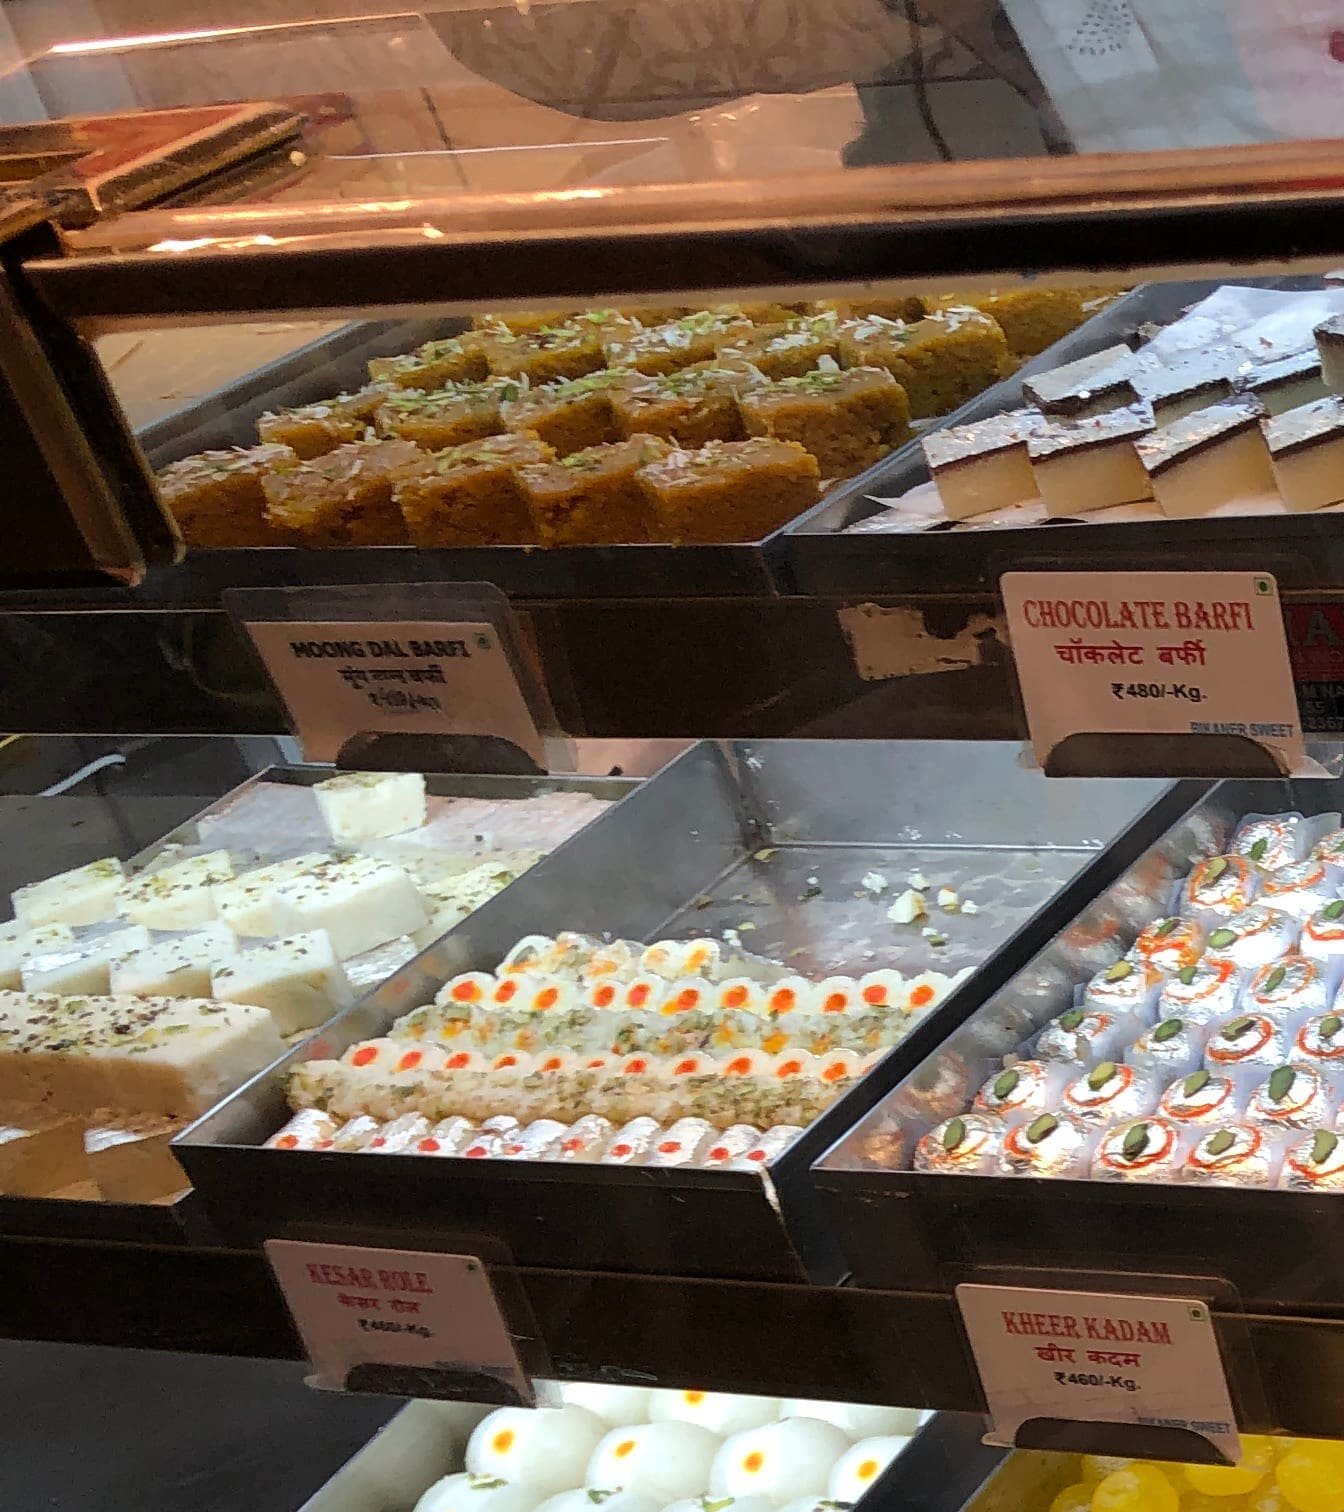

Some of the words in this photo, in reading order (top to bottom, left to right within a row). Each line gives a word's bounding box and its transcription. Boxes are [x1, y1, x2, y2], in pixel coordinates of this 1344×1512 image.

[1024, 600, 1169, 630] CHOCOLATE
[1176, 602, 1255, 632] BARFI
[366, 640, 410, 657] DAL
[1054, 638, 1143, 666] चॉकलेट
[1157, 638, 1207, 666] बर्फी
[1112, 683, 1207, 702] ₹480/-Kg.
[1249, 722, 1293, 737] SWEET
[1002, 1311, 1080, 1340] KHEER
[1082, 1316, 1174, 1345] KADAM
[1034, 1343, 1077, 1364] खीर
[1085, 1349, 1141, 1368] कदम
